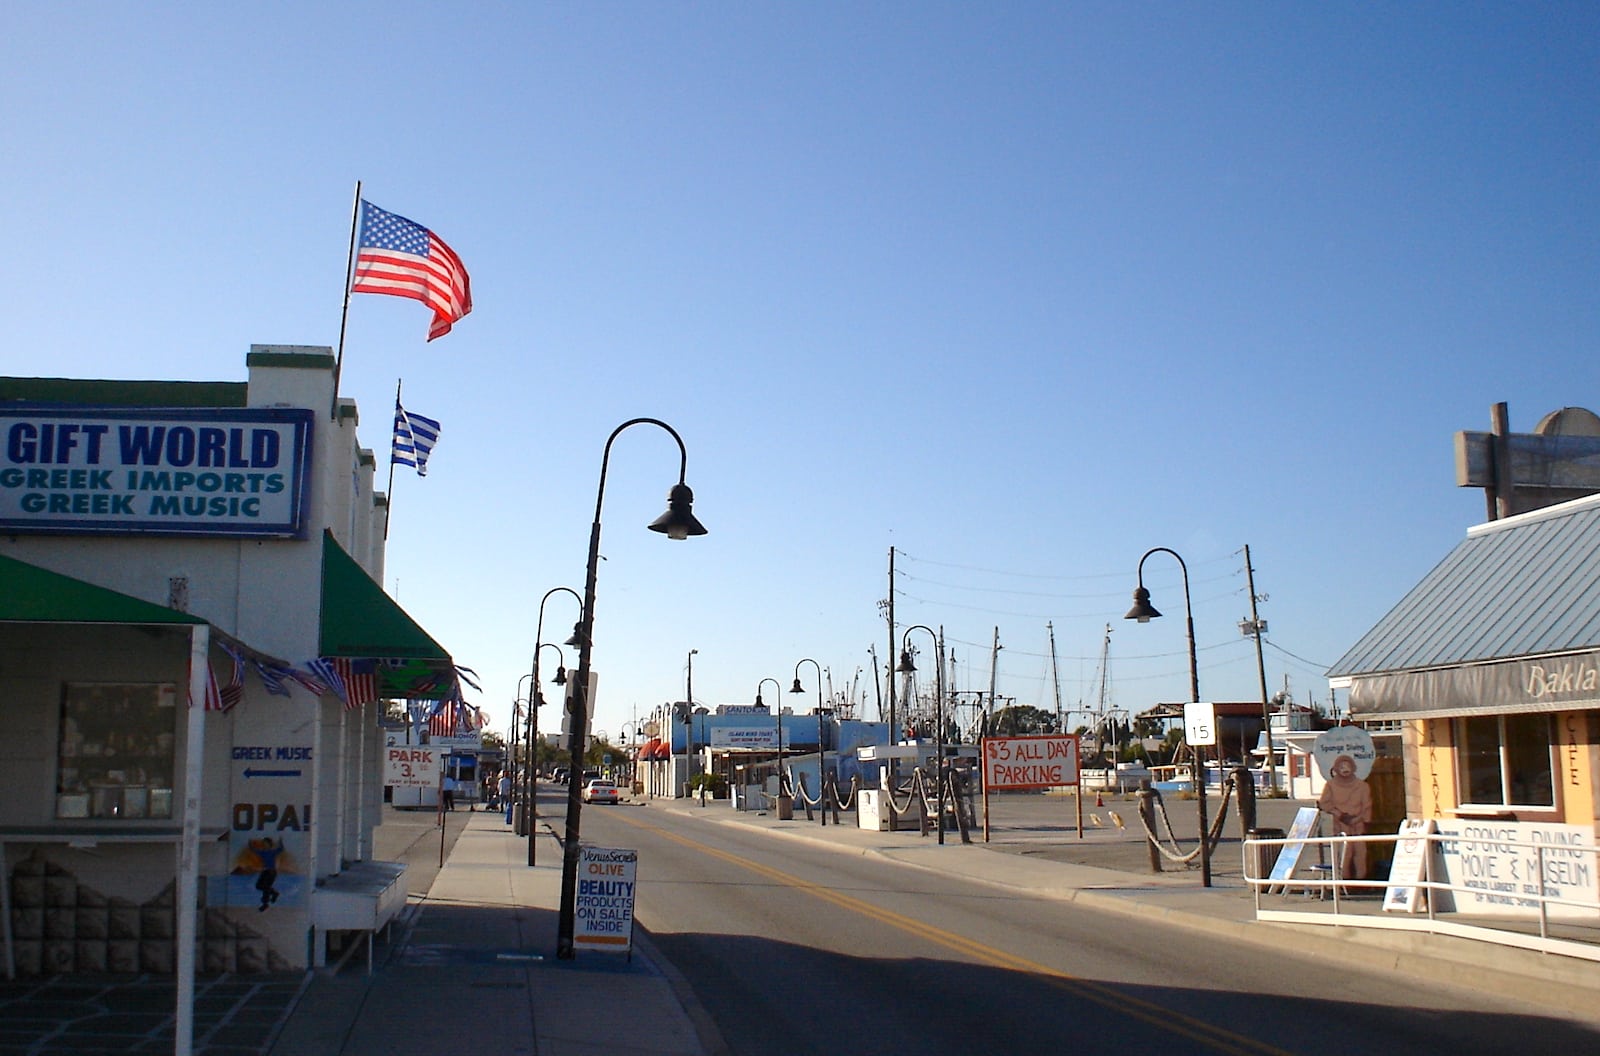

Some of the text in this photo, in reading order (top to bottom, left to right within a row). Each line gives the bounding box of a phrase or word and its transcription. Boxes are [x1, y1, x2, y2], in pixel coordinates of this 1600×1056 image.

[7, 422, 280, 468] GIFT WORLD
[0, 468, 285, 493] GREEK IMPORTS
[20, 493, 260, 517] GREEK MUSIC
[1193, 725, 1209, 739] 15
[232, 747, 313, 760] GREEK MUSIC
[389, 750, 432, 762] PARK
[988, 741, 1071, 762] $3 ALL DAY
[993, 764, 1062, 784] PARKING
[233, 803, 311, 831] OPA!
[1464, 827, 1518, 855] SPONGE
[588, 863, 624, 876] OLIVE
[580, 880, 633, 897] BEAUTY
[577, 896, 632, 908] PRODUCTS
[577, 908, 631, 921] ON SALE
[586, 920, 624, 932] INSIDE
